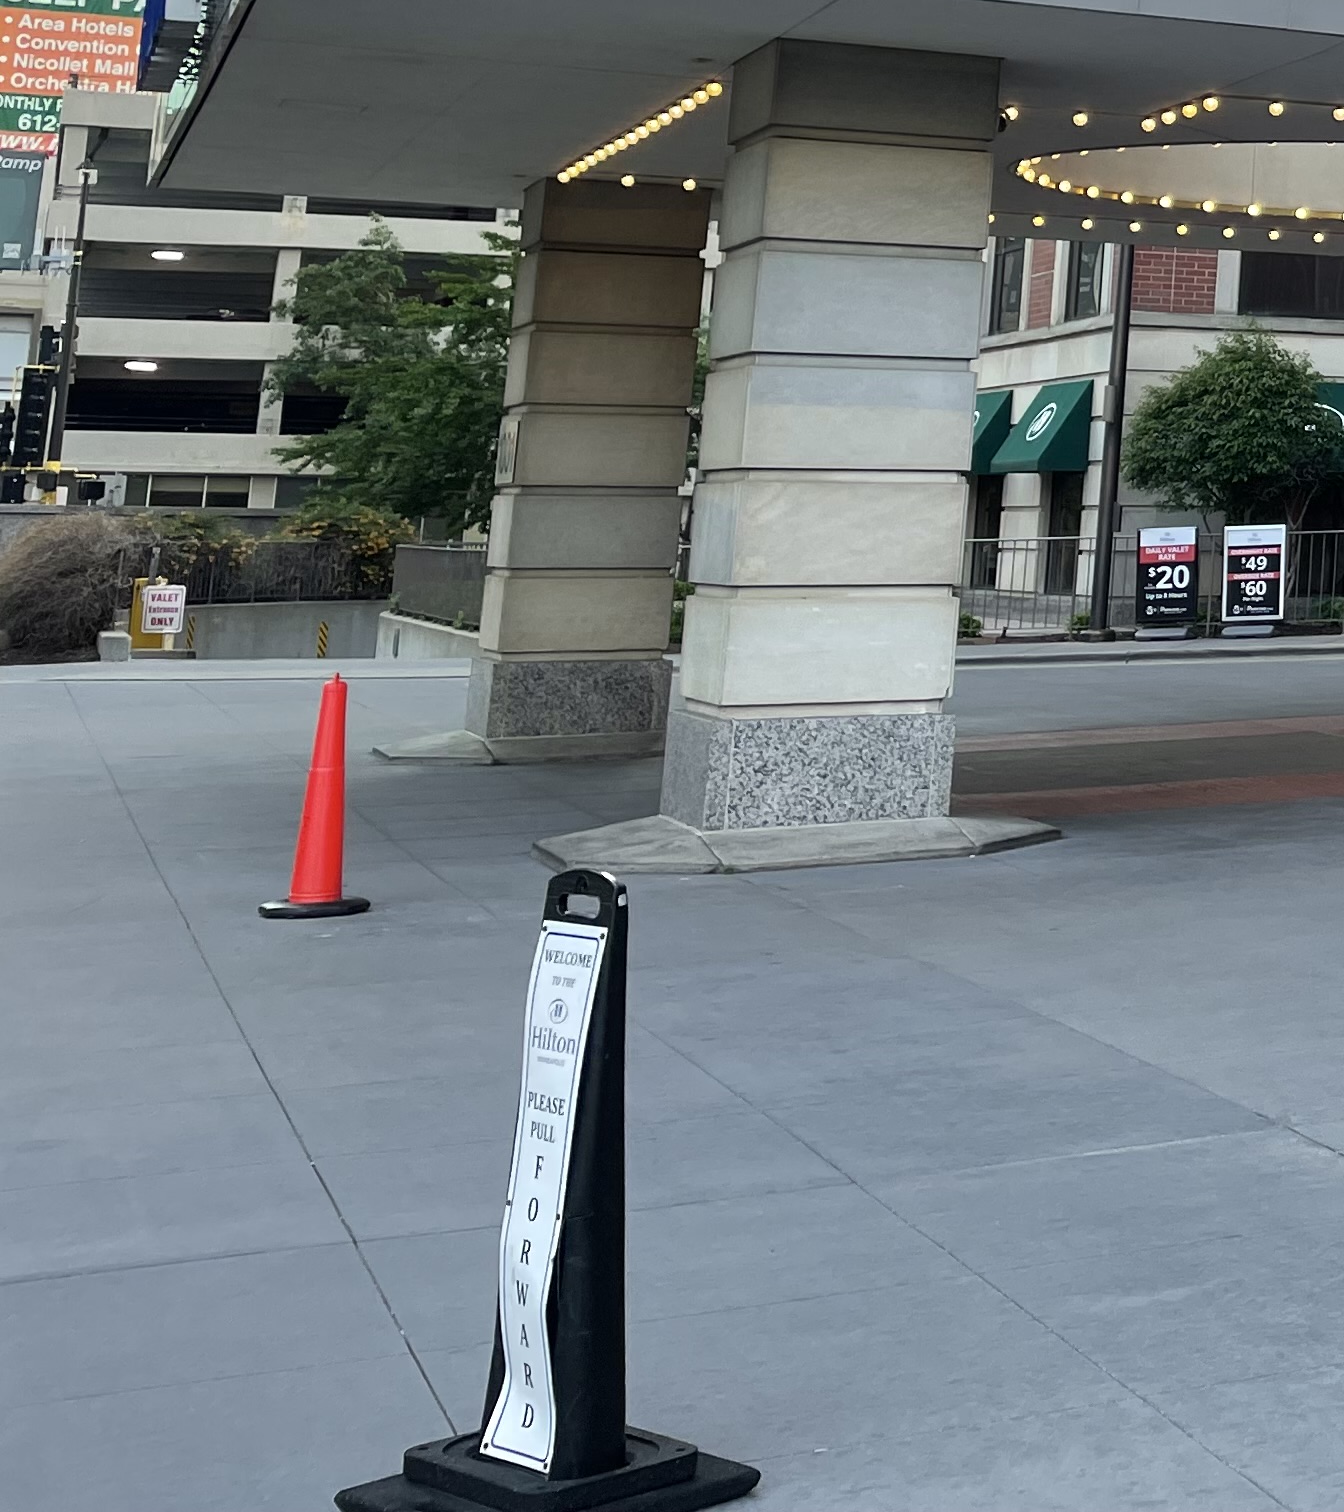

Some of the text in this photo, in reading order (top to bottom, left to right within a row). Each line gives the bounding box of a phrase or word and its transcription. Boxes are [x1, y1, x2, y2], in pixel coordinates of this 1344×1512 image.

[17, 13, 134, 37] Area Hotels
[15, 33, 129, 56] Convention
[13, 52, 135, 76] Nicollet Mall
[10, 72, 109, 92] Orchetra
[0, 154, 42, 173] amp
[1145, 545, 1189, 555] DAILY VALET
[1158, 553, 1176, 561] RATE
[1241, 555, 1267, 571] $49
[1148, 564, 1190, 589] $20
[151, 593, 179, 602] VALET
[1240, 580, 1267, 596] $60
[151, 617, 174, 626] ONLY
[545, 948, 593, 969] WELCOME
[551, 975, 562, 987] TO
[531, 1025, 577, 1055] Hilton
[527, 1090, 566, 1117] PLEASE
[529, 1120, 556, 1144] PULL
[515, 1154, 545, 1430] FORWARD
